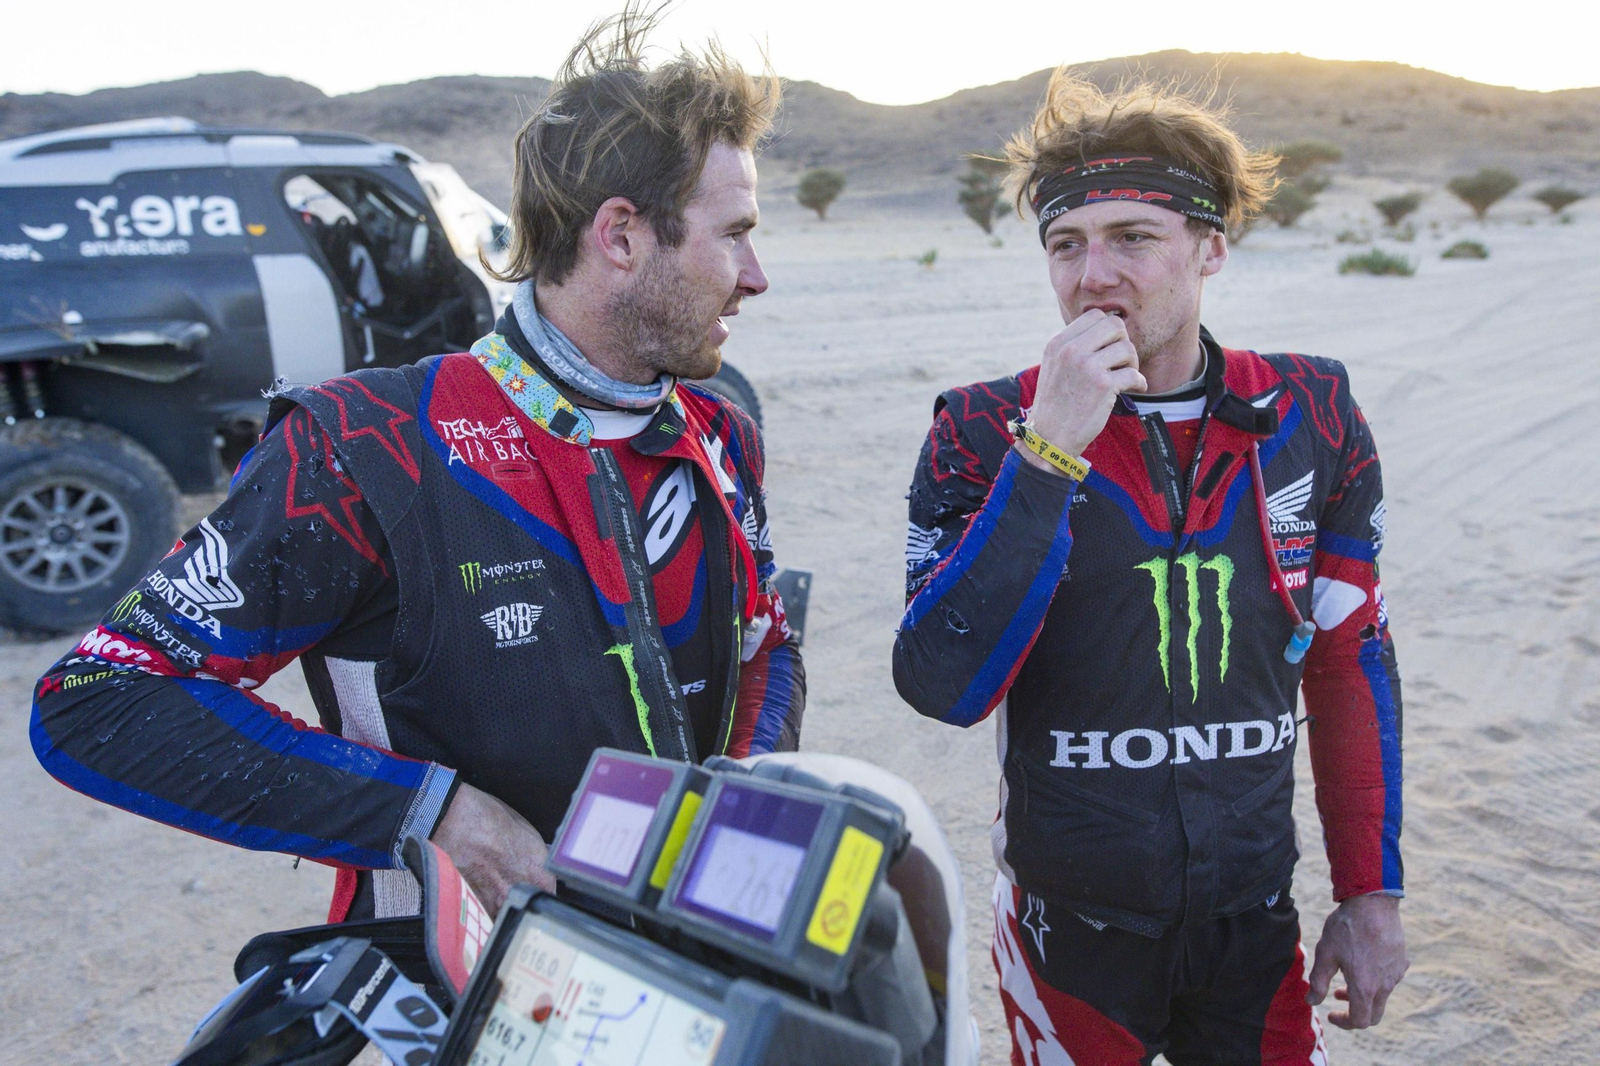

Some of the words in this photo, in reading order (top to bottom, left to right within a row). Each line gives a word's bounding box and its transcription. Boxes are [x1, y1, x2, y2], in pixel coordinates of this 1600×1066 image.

[448, 440, 490, 466] AIR
[482, 558, 546, 579] MONSTER
[494, 572, 541, 585] ENERGY
[146, 569, 223, 640] HONDA
[131, 604, 203, 667] MONSTER
[1050, 710, 1296, 769] HONDA
[485, 1016, 528, 1053] 616.7
